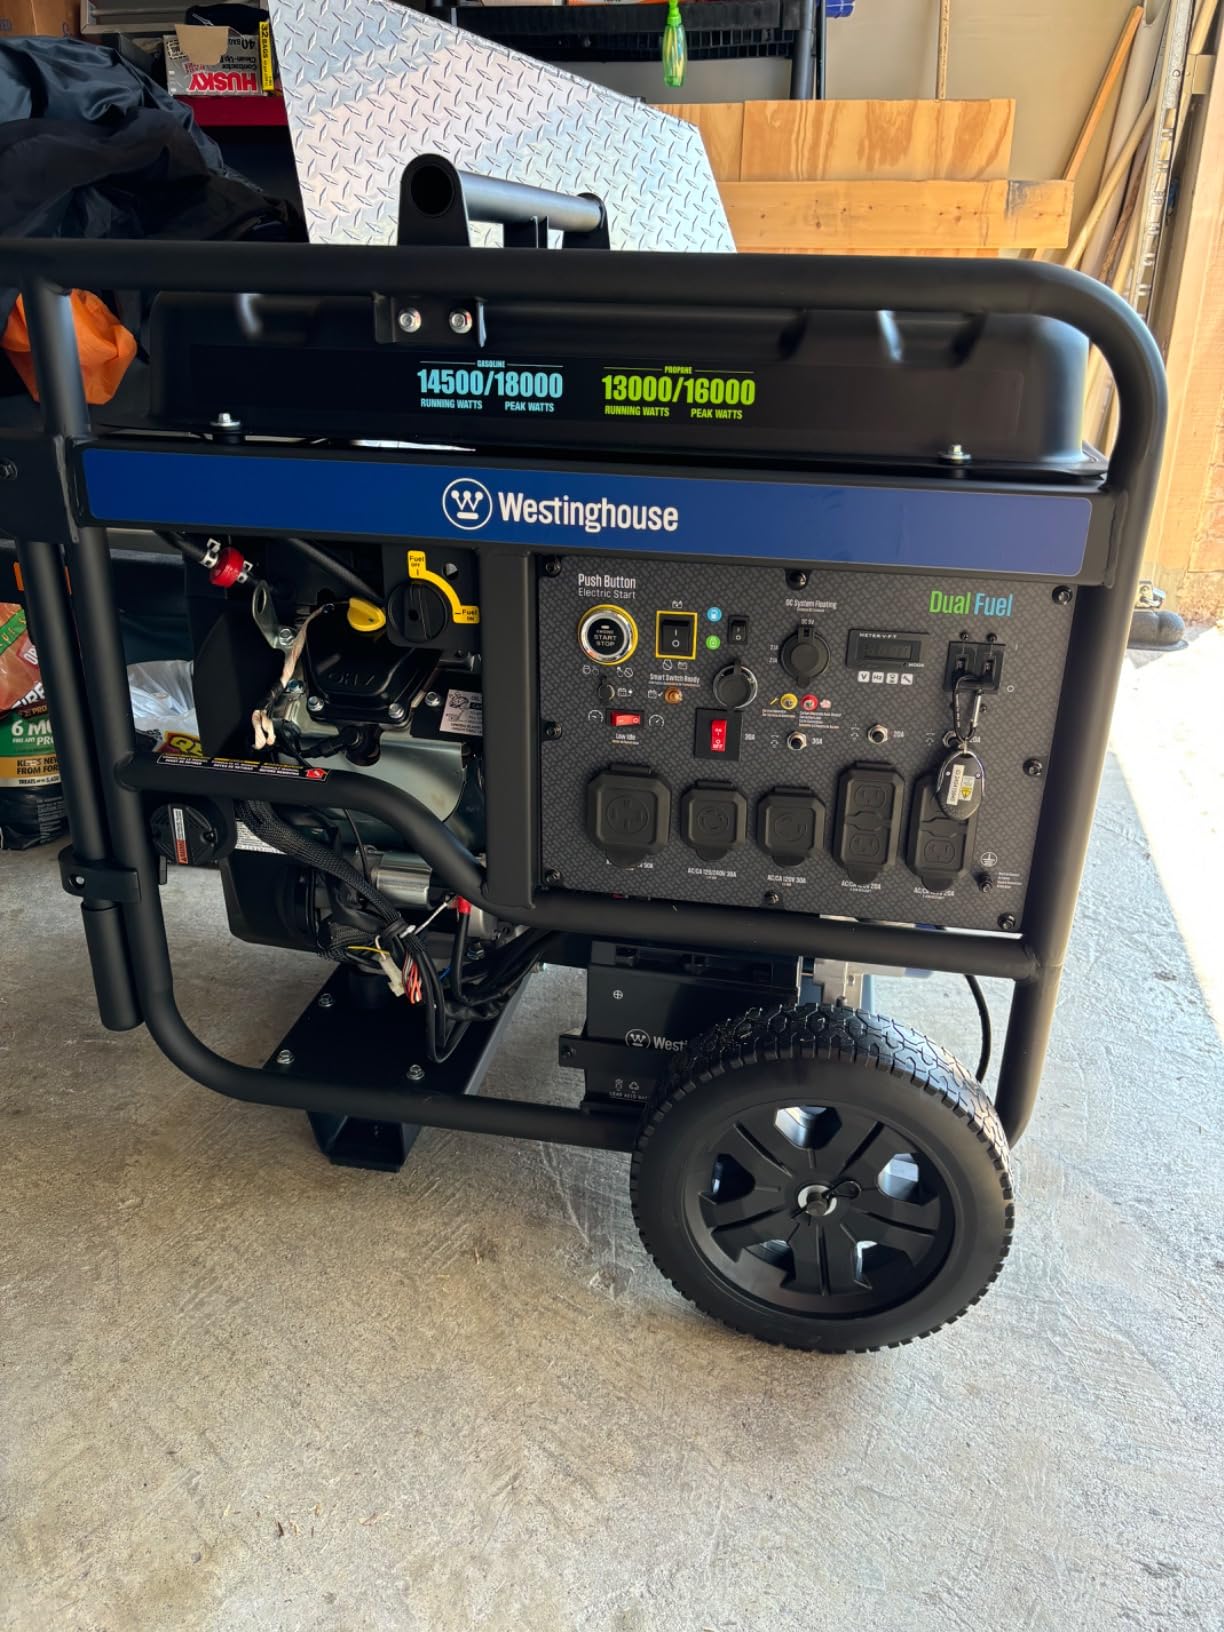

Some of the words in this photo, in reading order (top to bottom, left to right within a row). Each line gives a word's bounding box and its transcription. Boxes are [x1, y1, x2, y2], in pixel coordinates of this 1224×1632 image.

[189, 72, 257, 92] HUSKY
[477, 360, 505, 368] GASOLINE
[664, 366, 692, 374] PROPANE
[417, 369, 563, 398] 14500/18000
[602, 375, 755, 405] 13000/16000
[420, 398, 455, 408] RUNNING
[456, 400, 483, 410] WATTS
[504, 401, 526, 411] PEAK
[527, 403, 555, 412] WATTS
[604, 405, 641, 416] RUNNING
[642, 407, 670, 417] WATTS
[690, 408, 713, 418] PEAK
[714, 410, 743, 420] WATTS
[498, 491, 679, 533] Westinghouse
[578, 573, 602, 587] Push
[603, 574, 636, 589] Button
[578, 587, 611, 598] Electric
[613, 589, 636, 599] Start
[929, 590, 972, 615] Dual
[973, 592, 1014, 617] Fuel
[11, 720, 24, 736] 6
[16, 767, 41, 775] FROM
